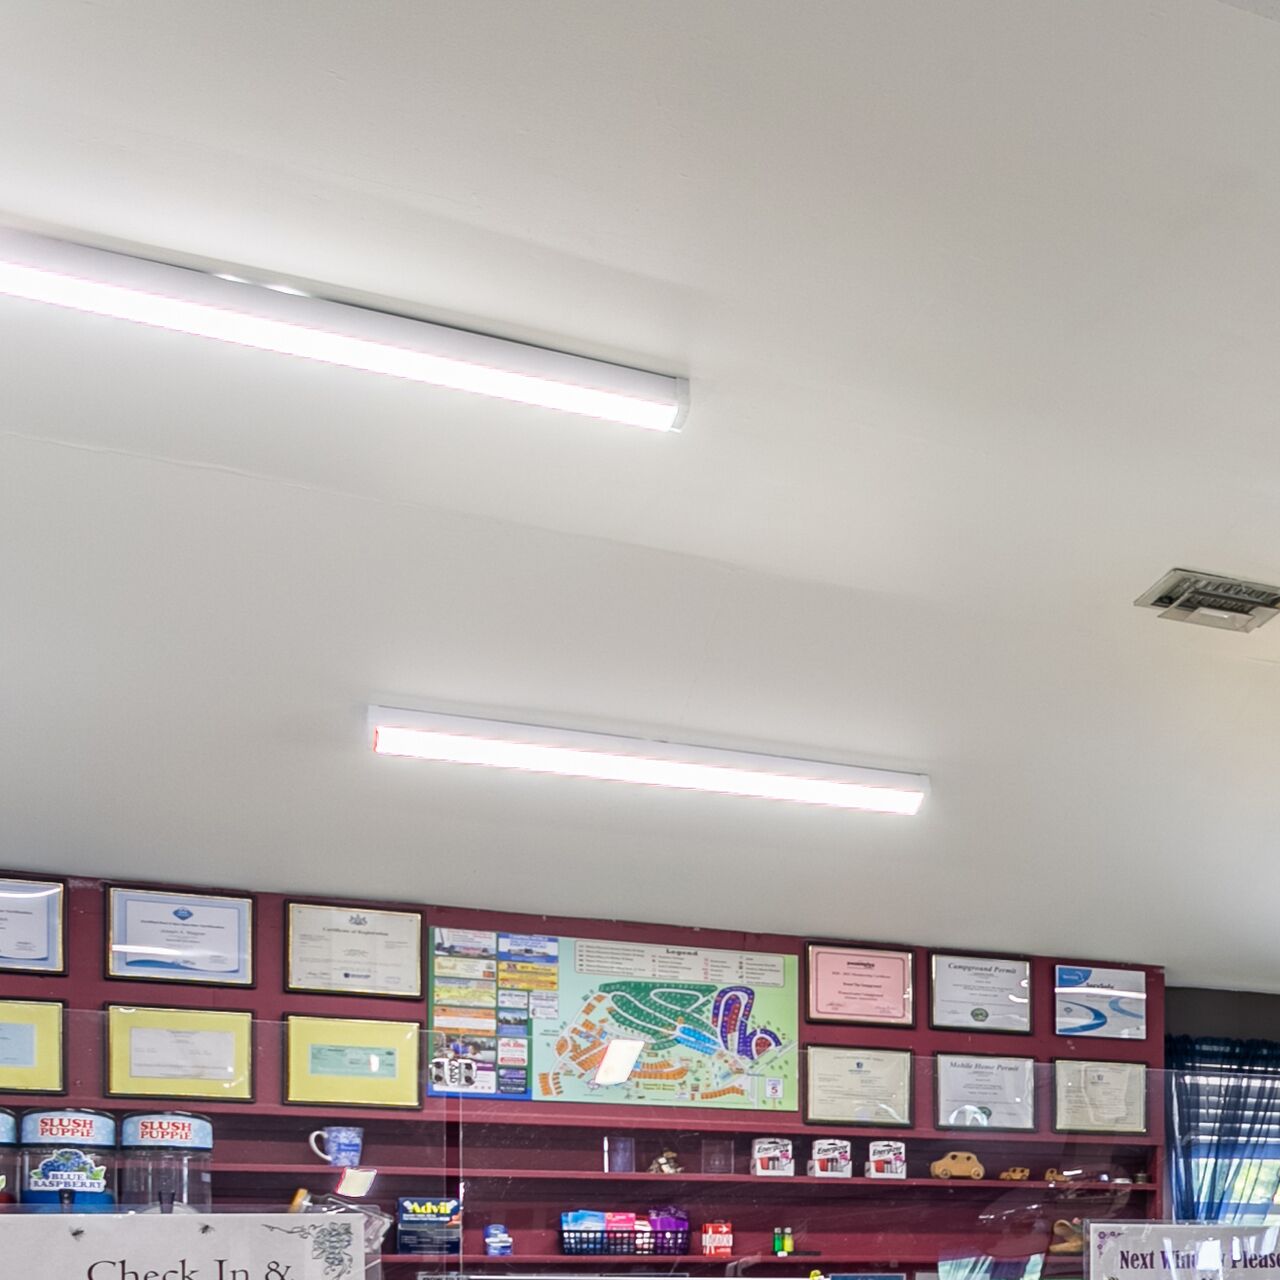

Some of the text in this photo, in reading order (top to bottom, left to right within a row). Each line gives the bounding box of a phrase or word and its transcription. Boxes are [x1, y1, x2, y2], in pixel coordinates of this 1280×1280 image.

[666, 948, 698, 958] Legend
[948, 963, 1017, 974] Campground Permit
[974, 1063, 996, 1072] Home
[998, 1064, 1019, 1072] Permit
[39, 1118, 94, 1129] SLUSH
[140, 1121, 192, 1132] SLUSH
[33, 1180, 102, 1189] RASPBERRY
[410, 1202, 451, 1214] Advil
[1120, 1251, 1154, 1269] Next
[1160, 1251, 1226, 1269] Win
